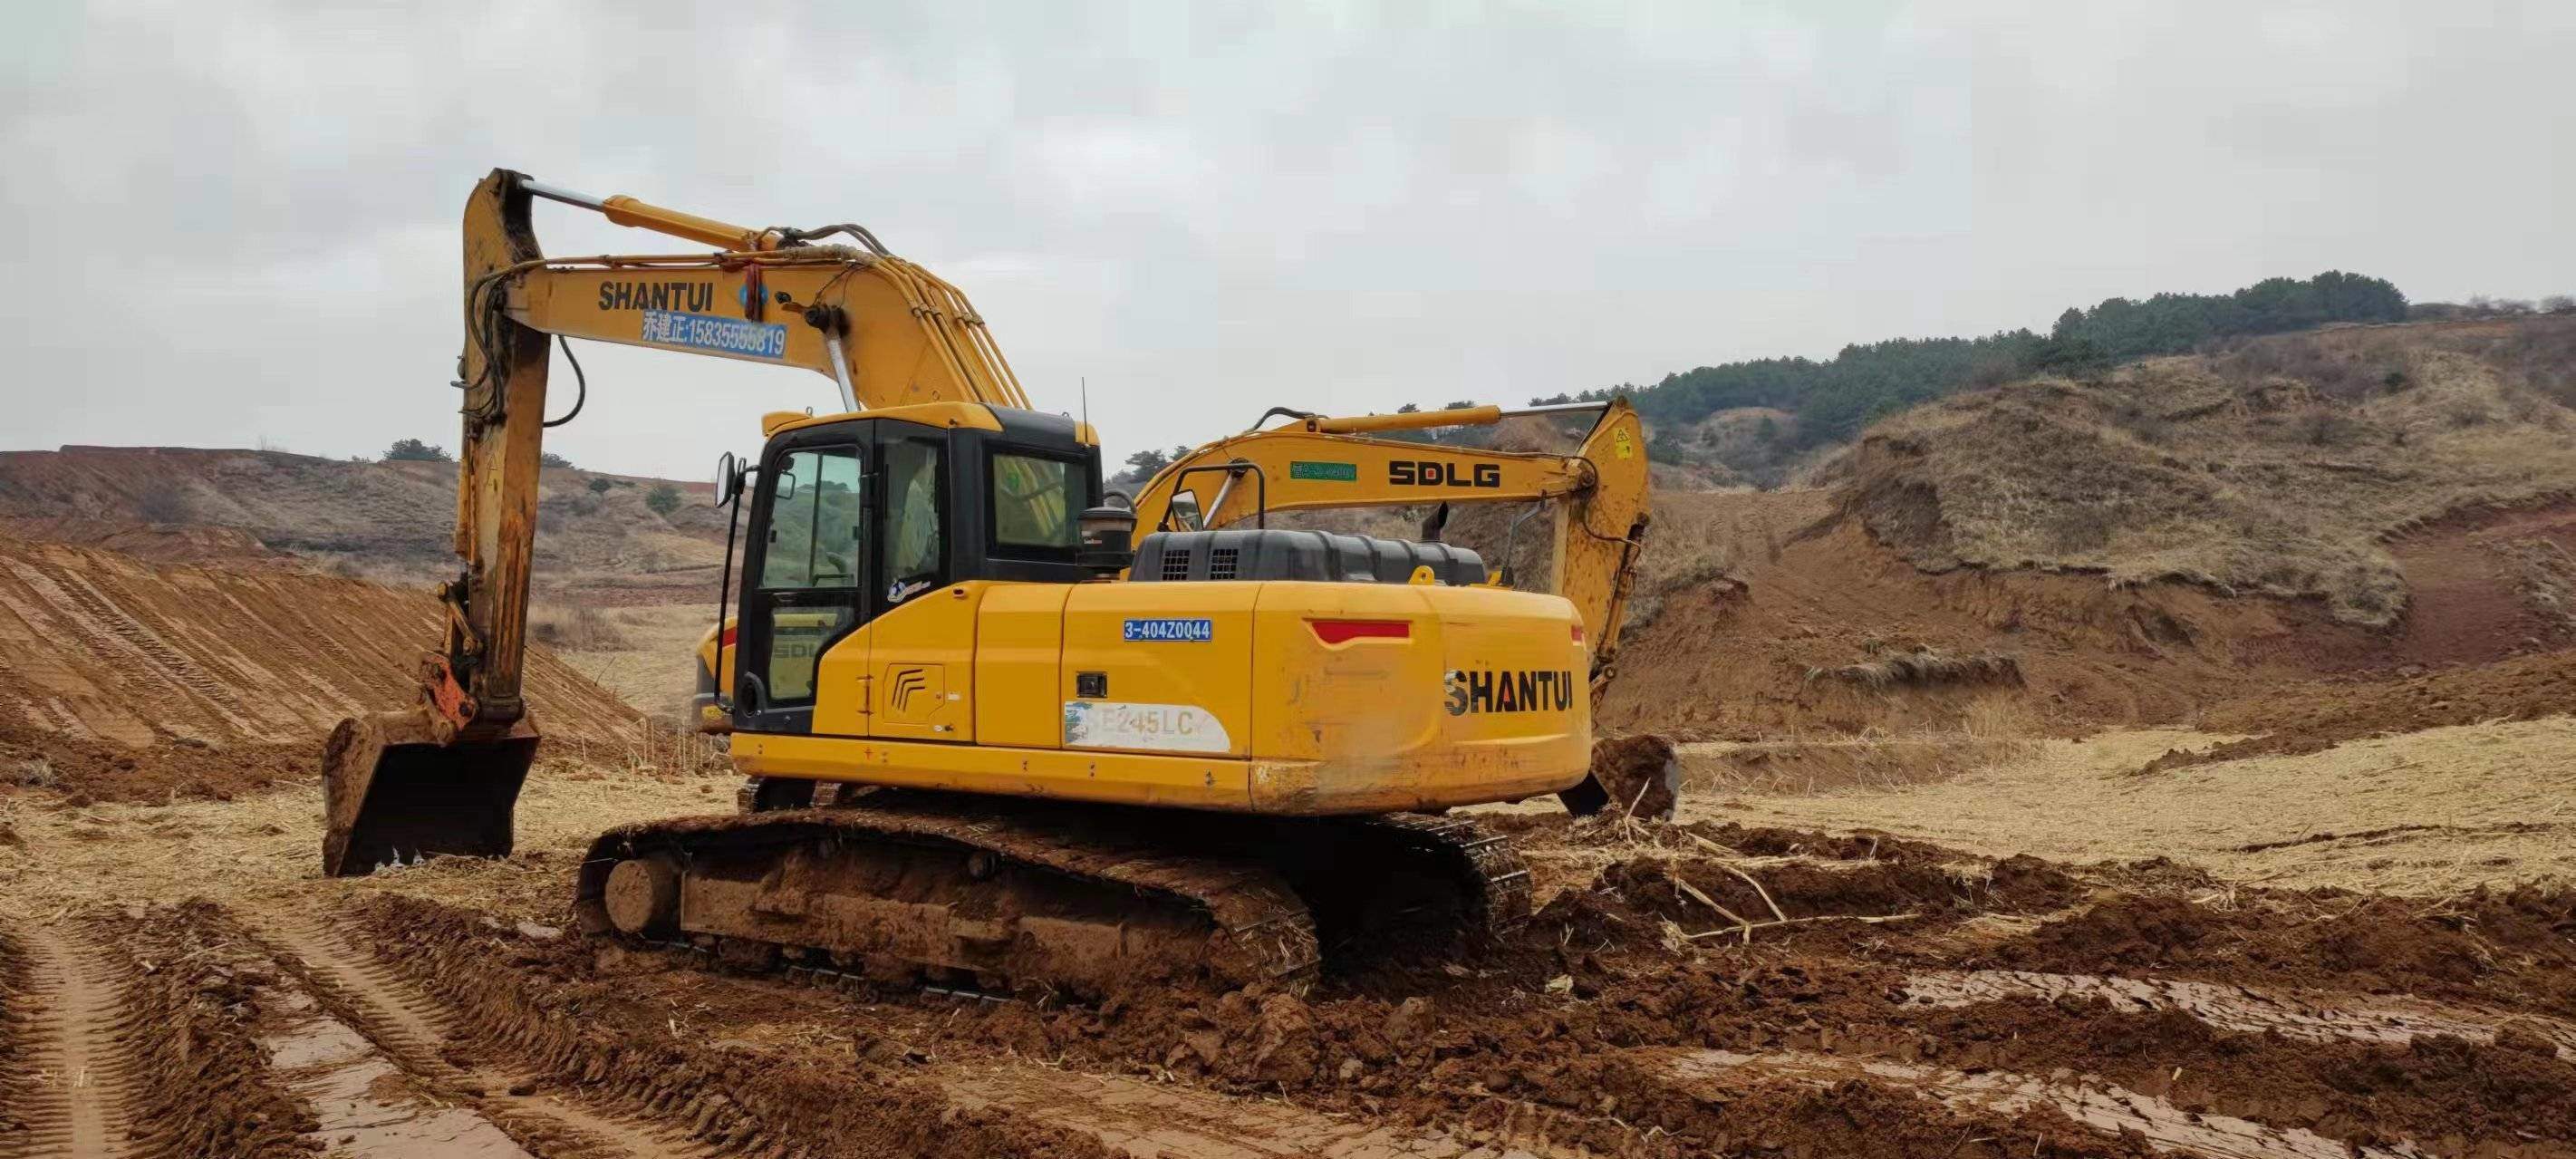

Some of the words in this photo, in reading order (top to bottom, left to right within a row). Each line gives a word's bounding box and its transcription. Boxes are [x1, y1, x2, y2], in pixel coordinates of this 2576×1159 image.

[598, 280, 713, 312] SHANTUI
[1389, 460, 1500, 488] SDLG
[1124, 621, 1211, 639] 3-404Z0044
[1443, 670, 1573, 716] SHANTUI
